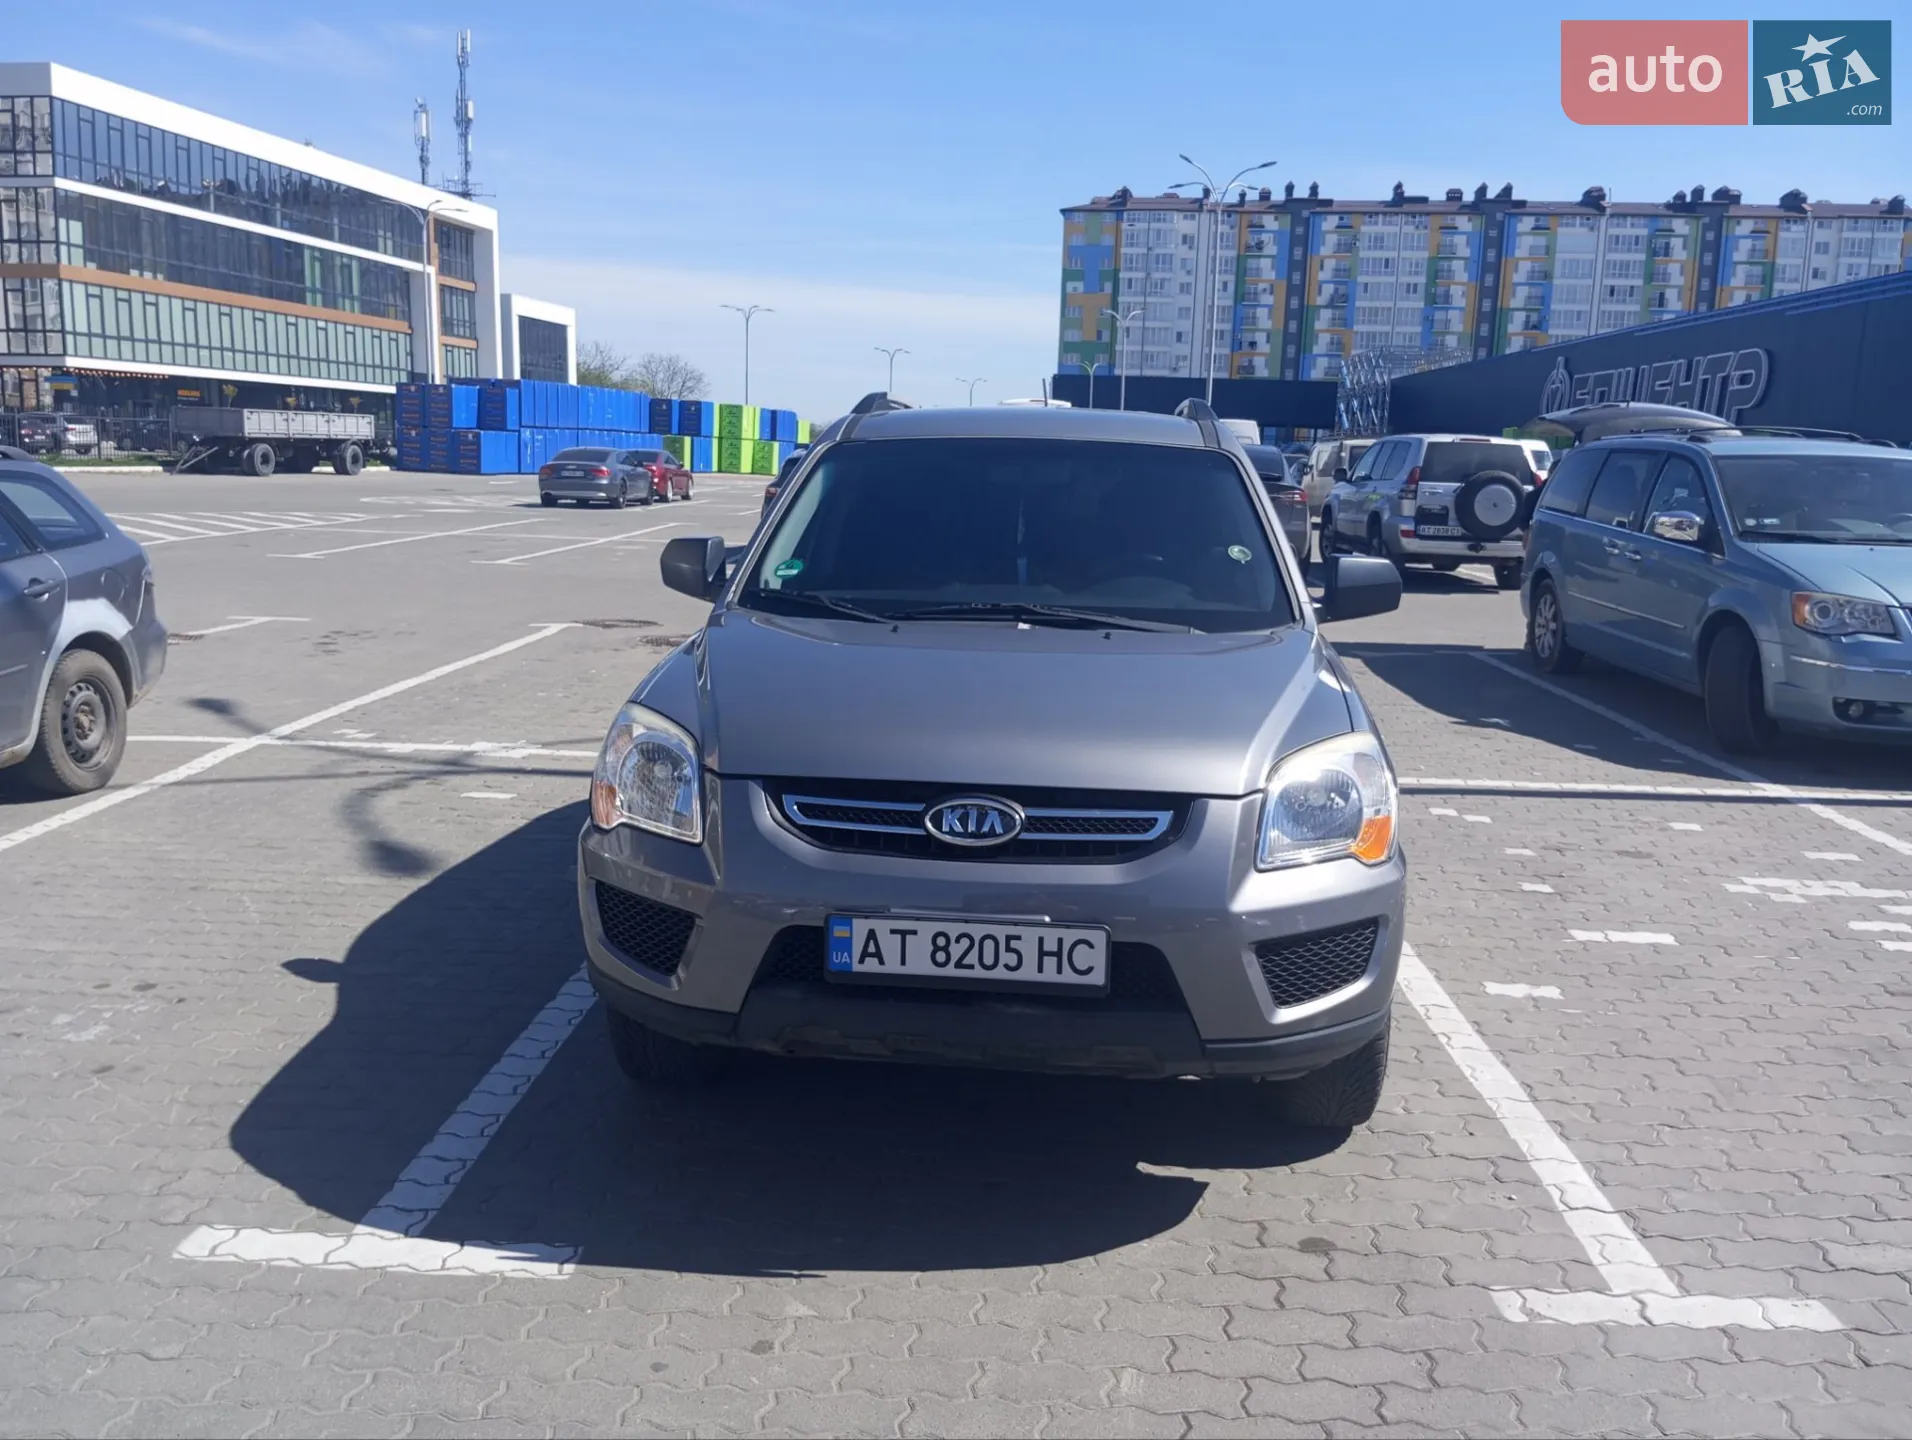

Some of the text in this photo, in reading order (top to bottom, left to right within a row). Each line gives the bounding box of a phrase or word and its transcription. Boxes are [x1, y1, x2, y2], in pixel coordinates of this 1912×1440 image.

[942, 808, 1004, 835] KIA
[832, 951, 850, 964] UA
[857, 928, 1096, 976] AT 8205 HC
